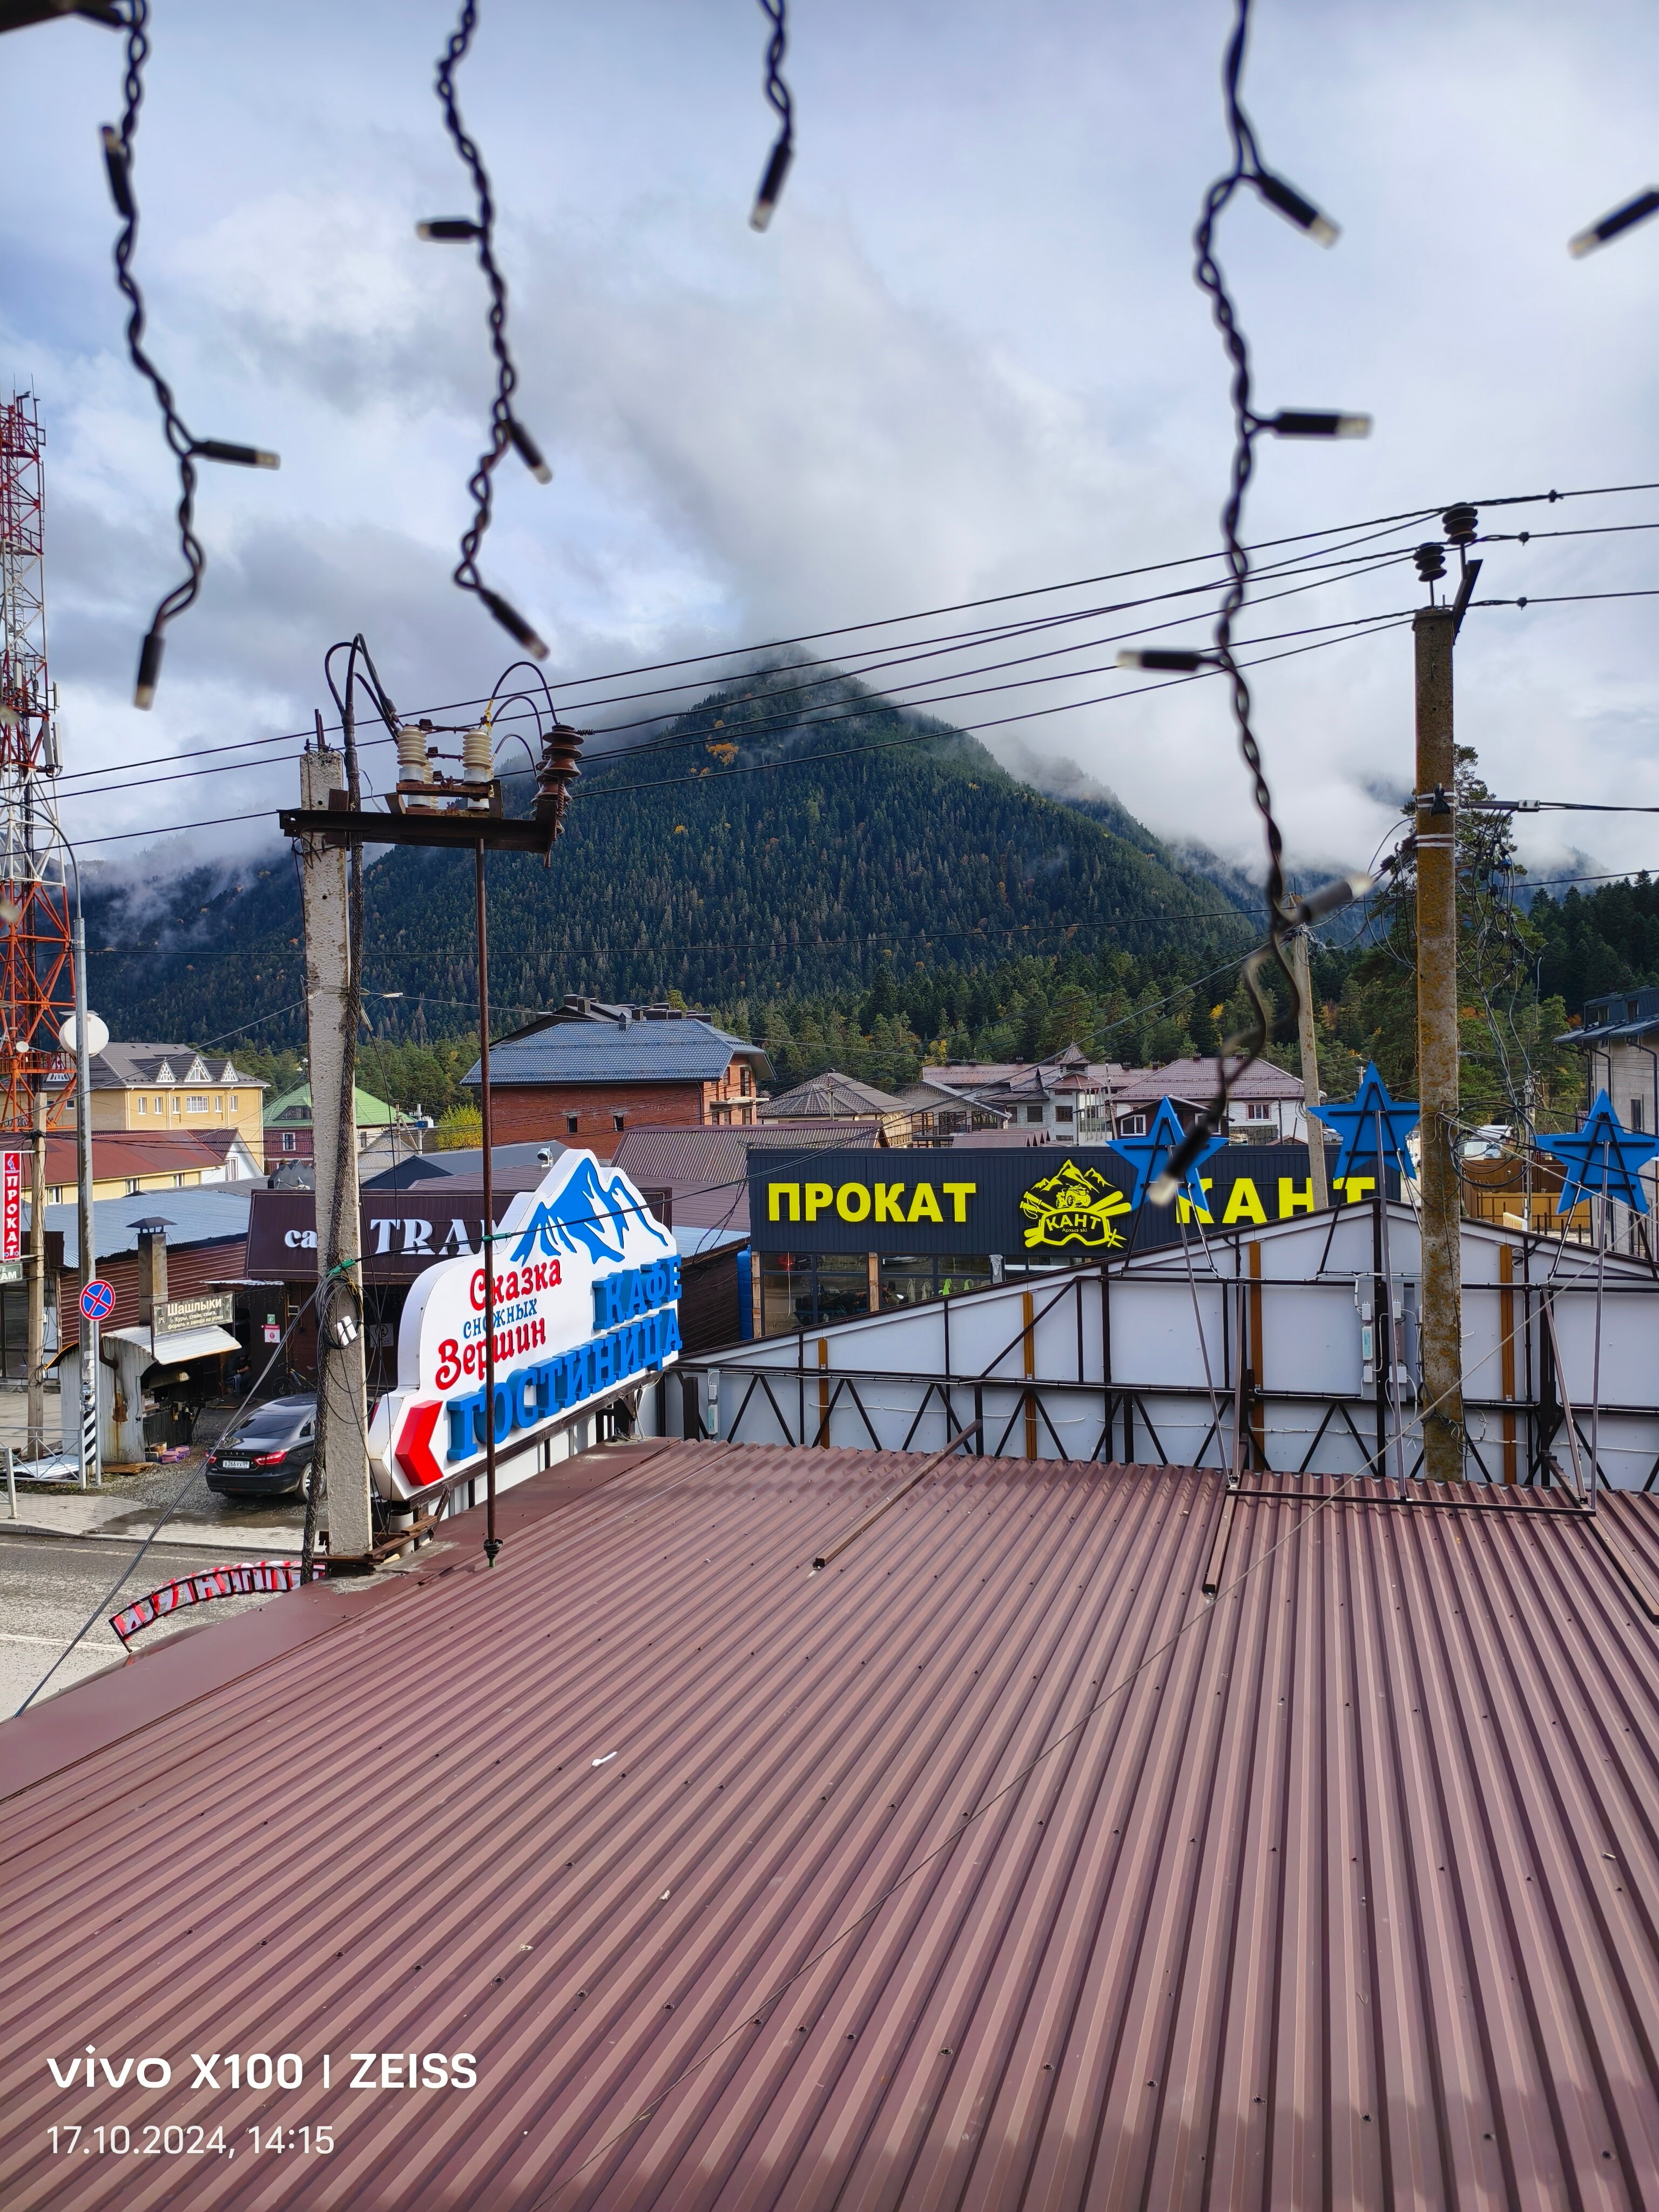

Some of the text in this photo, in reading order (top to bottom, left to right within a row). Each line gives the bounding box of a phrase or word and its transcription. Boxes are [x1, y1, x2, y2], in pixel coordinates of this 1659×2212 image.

[6, 1175, 18, 1257] ПРОКАТ
[768, 1183, 976, 1222] ПРОКАТ
[1046, 1214, 1101, 1231] КАНТ
[370, 1218, 498, 1255] TRA
[167, 1298, 222, 1317] Шашлыки
[470, 1259, 562, 1311] Сказка
[591, 1255, 682, 1330] КАФЕ
[167, 1322, 186, 1330] форель
[434, 1317, 547, 1391] Вершин
[446, 1308, 683, 1461] ГОСТИНИЦА
